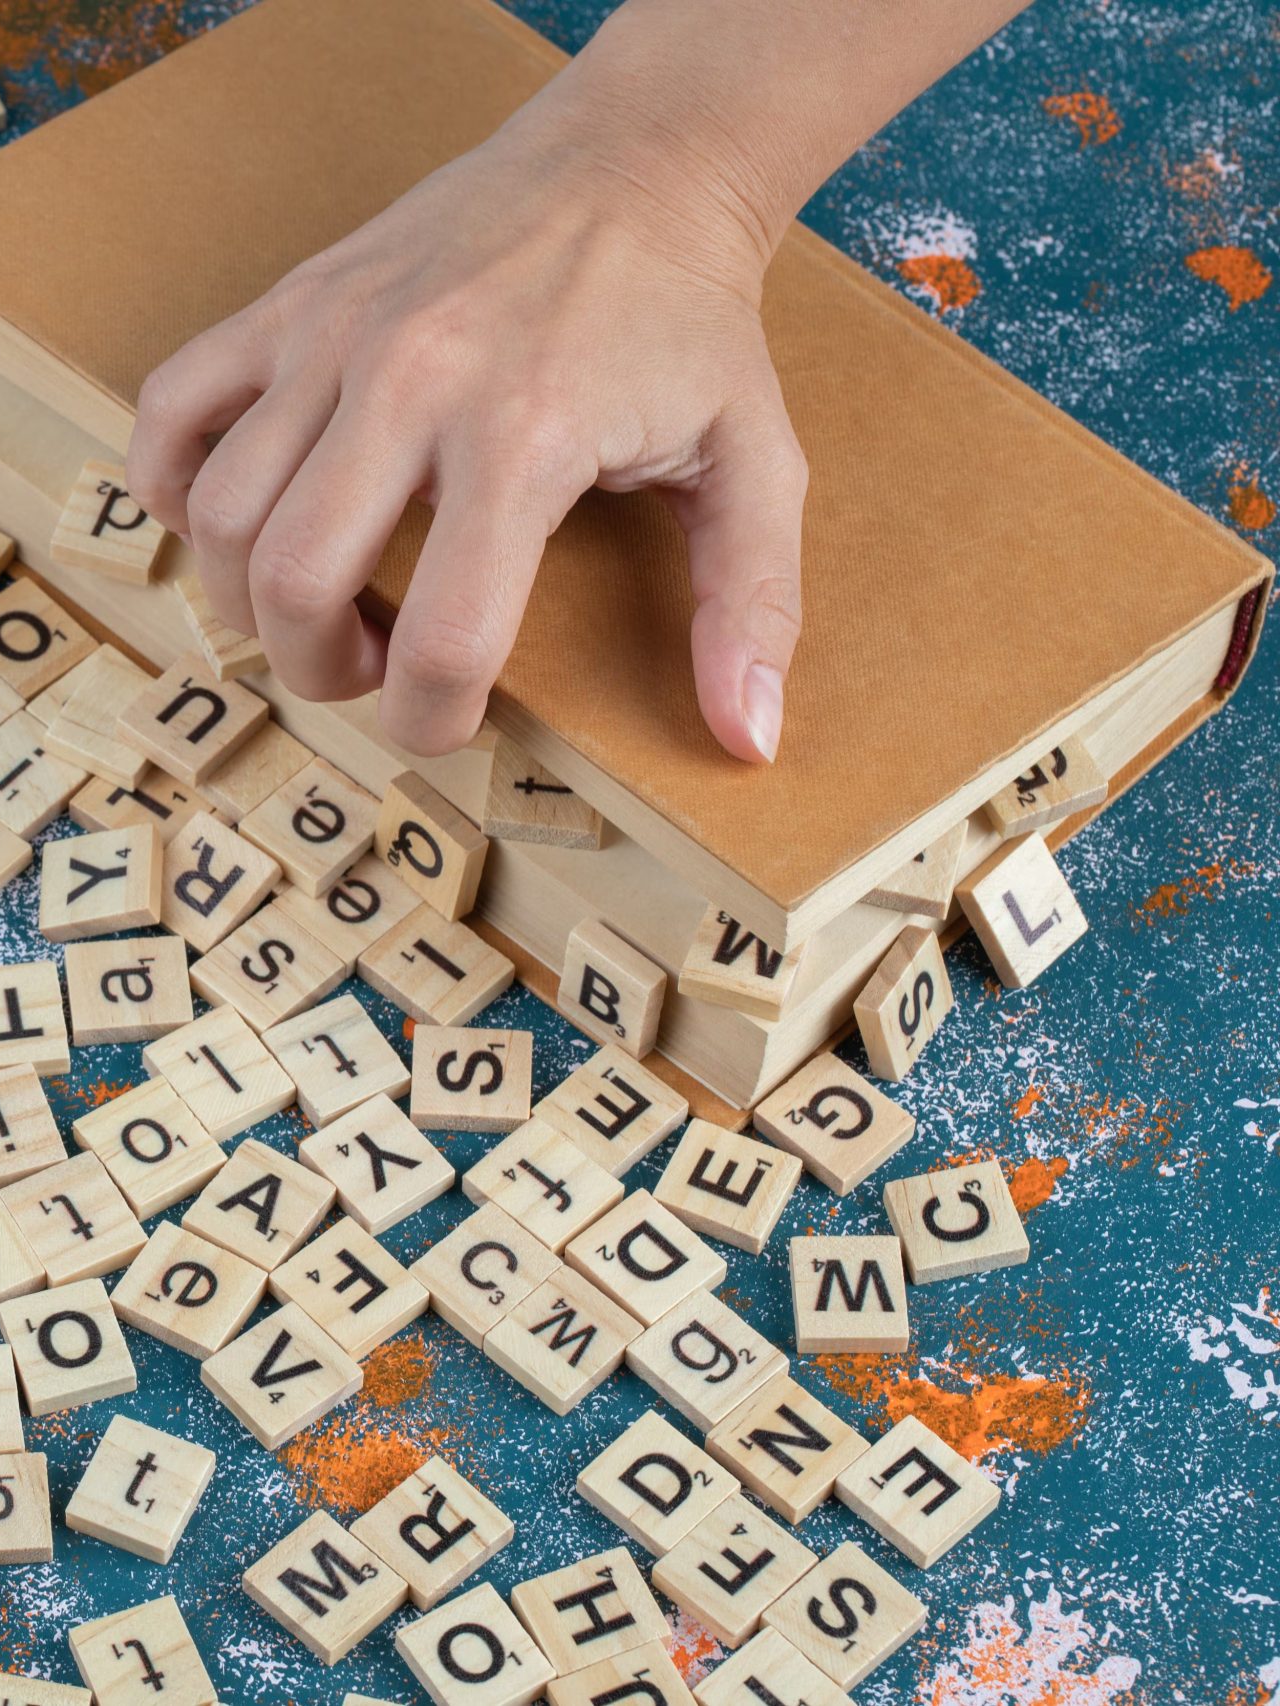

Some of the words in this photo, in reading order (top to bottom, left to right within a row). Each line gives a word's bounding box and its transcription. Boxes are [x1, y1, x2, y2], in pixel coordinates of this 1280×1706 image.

[291, 798, 346, 844] e
[66, 857, 128, 905] Y
[173, 843, 244, 917] R
[326, 876, 382, 925] e
[1001, 889, 1055, 947] L
[100, 966, 154, 1003] a
[578, 965, 621, 1026] B
[313, 1033, 359, 1078] t
[576, 1075, 652, 1141] E
[801, 1086, 874, 1140] G
[354, 1132, 422, 1193] Y
[517, 1158, 572, 1213] f
[688, 1150, 765, 1207] E
[51, 1194, 94, 1241] t
[218, 1173, 282, 1235] A
[616, 1220, 690, 1282] D
[161, 1261, 218, 1308] e
[334, 1248, 389, 1314] F
[671, 1320, 739, 1384] g
[749, 1405, 831, 1476] N
[126, 1453, 158, 1507] t
[618, 1453, 693, 1517] D
[880, 1447, 960, 1516] E
[399, 1491, 476, 1564] R
[278, 1540, 367, 1618] M
[697, 1547, 776, 1597] F
[554, 1578, 636, 1646] H
[124, 1639, 165, 1692] t
